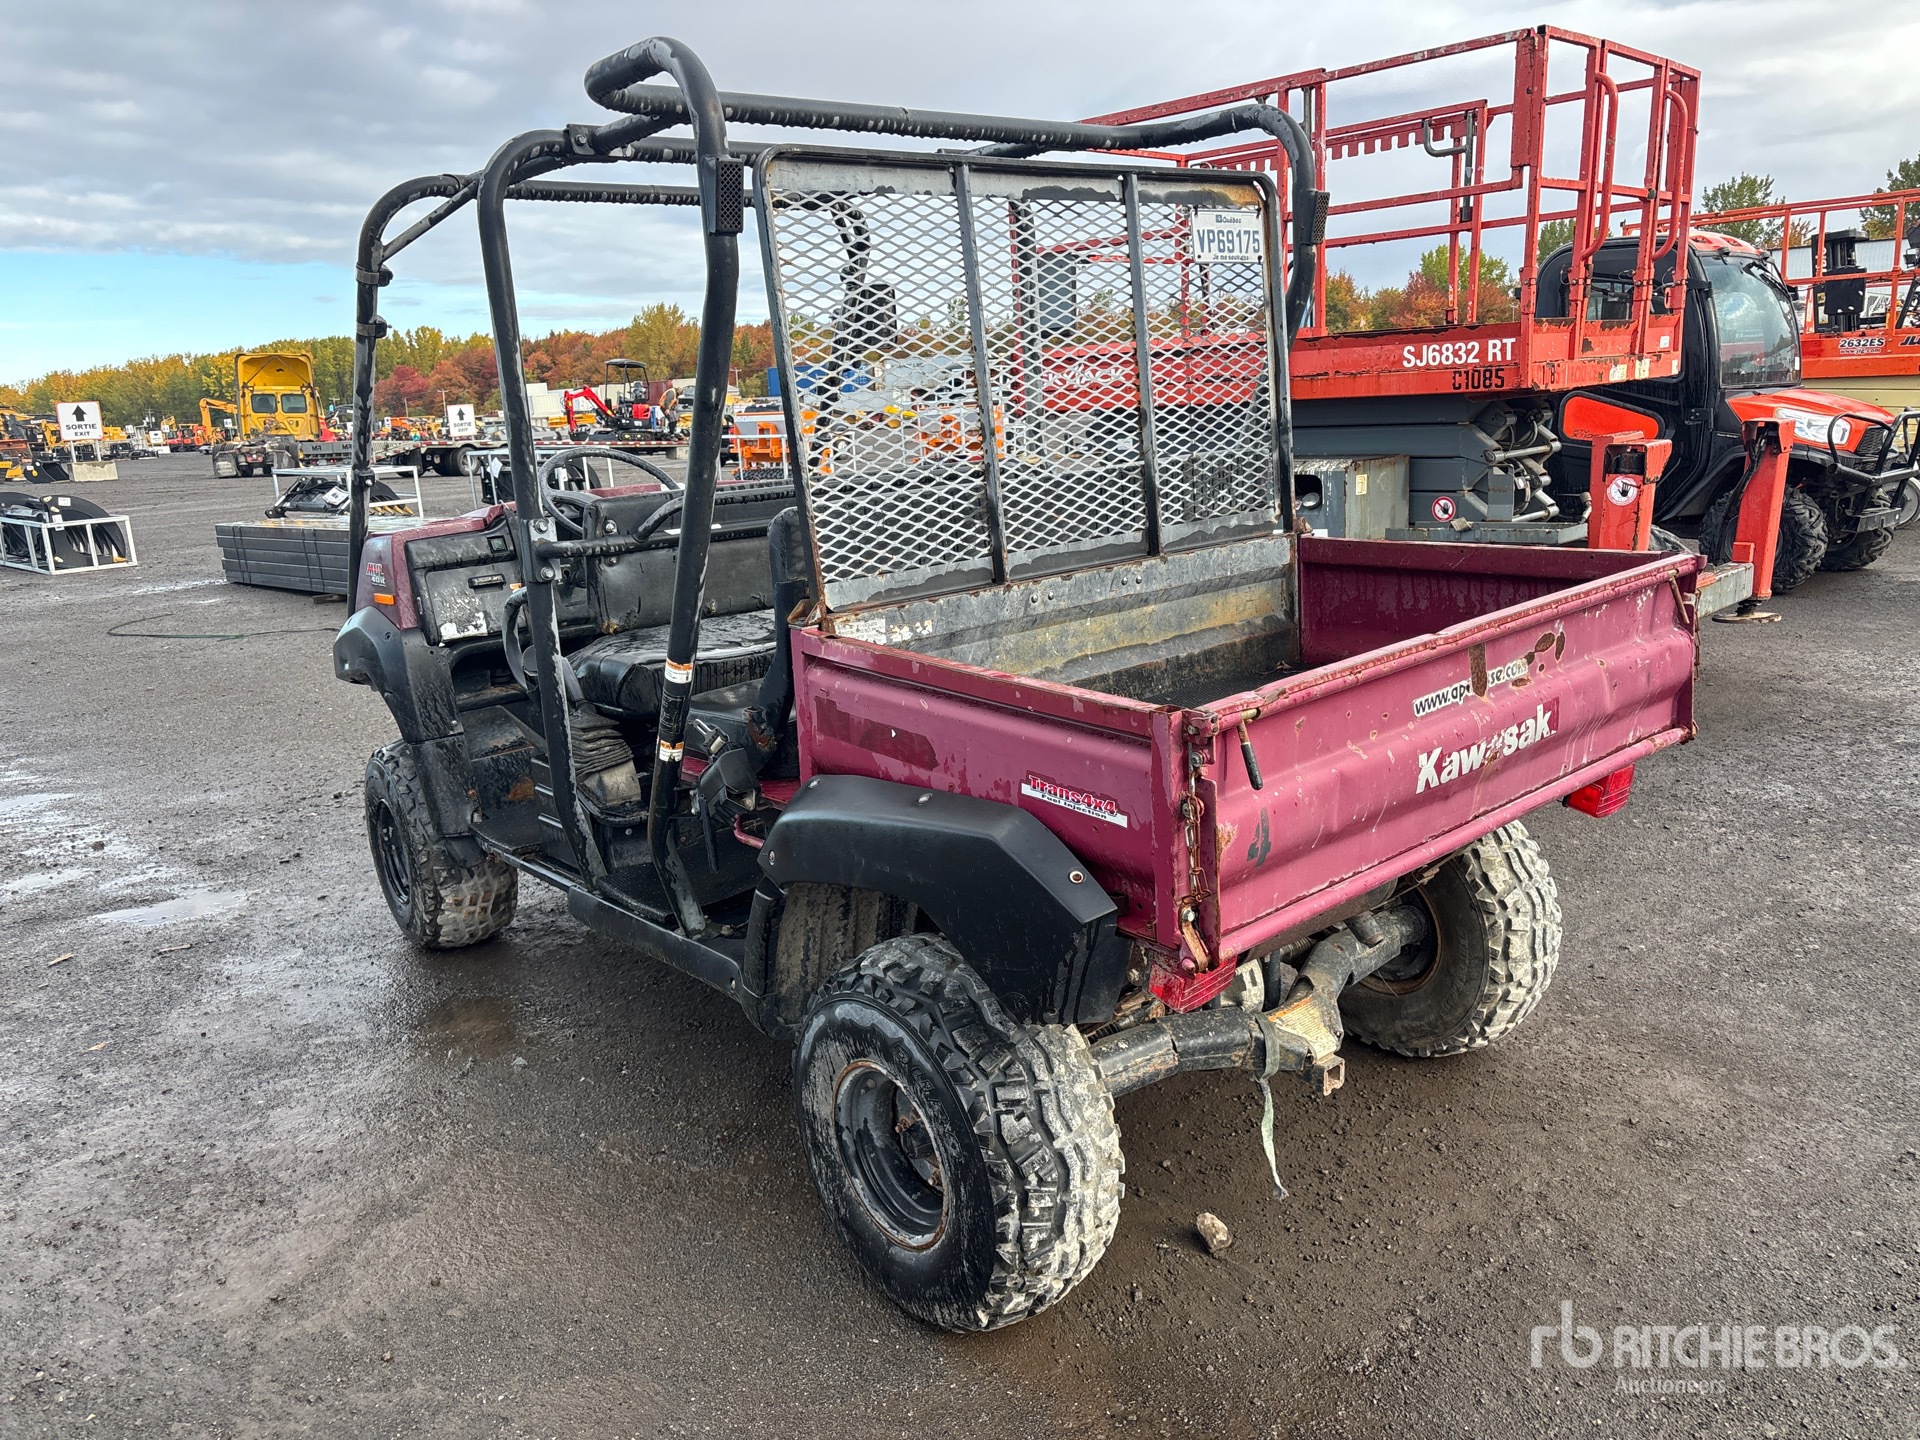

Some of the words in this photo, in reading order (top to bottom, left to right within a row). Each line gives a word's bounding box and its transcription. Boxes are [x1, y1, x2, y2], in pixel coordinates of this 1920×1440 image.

[1196, 229, 1260, 253] VP69175
[1402, 341, 1480, 368] SJ6832
[1487, 338, 1516, 362] RT
[1839, 338, 1885, 348] 2632ES
[1452, 367, 1505, 391] C1085
[65, 423, 97, 431] SORTIE
[1029, 775, 1118, 817] Trans4x4
[1041, 794, 1061, 804] Fuel
[1063, 801, 1107, 819] Injection
